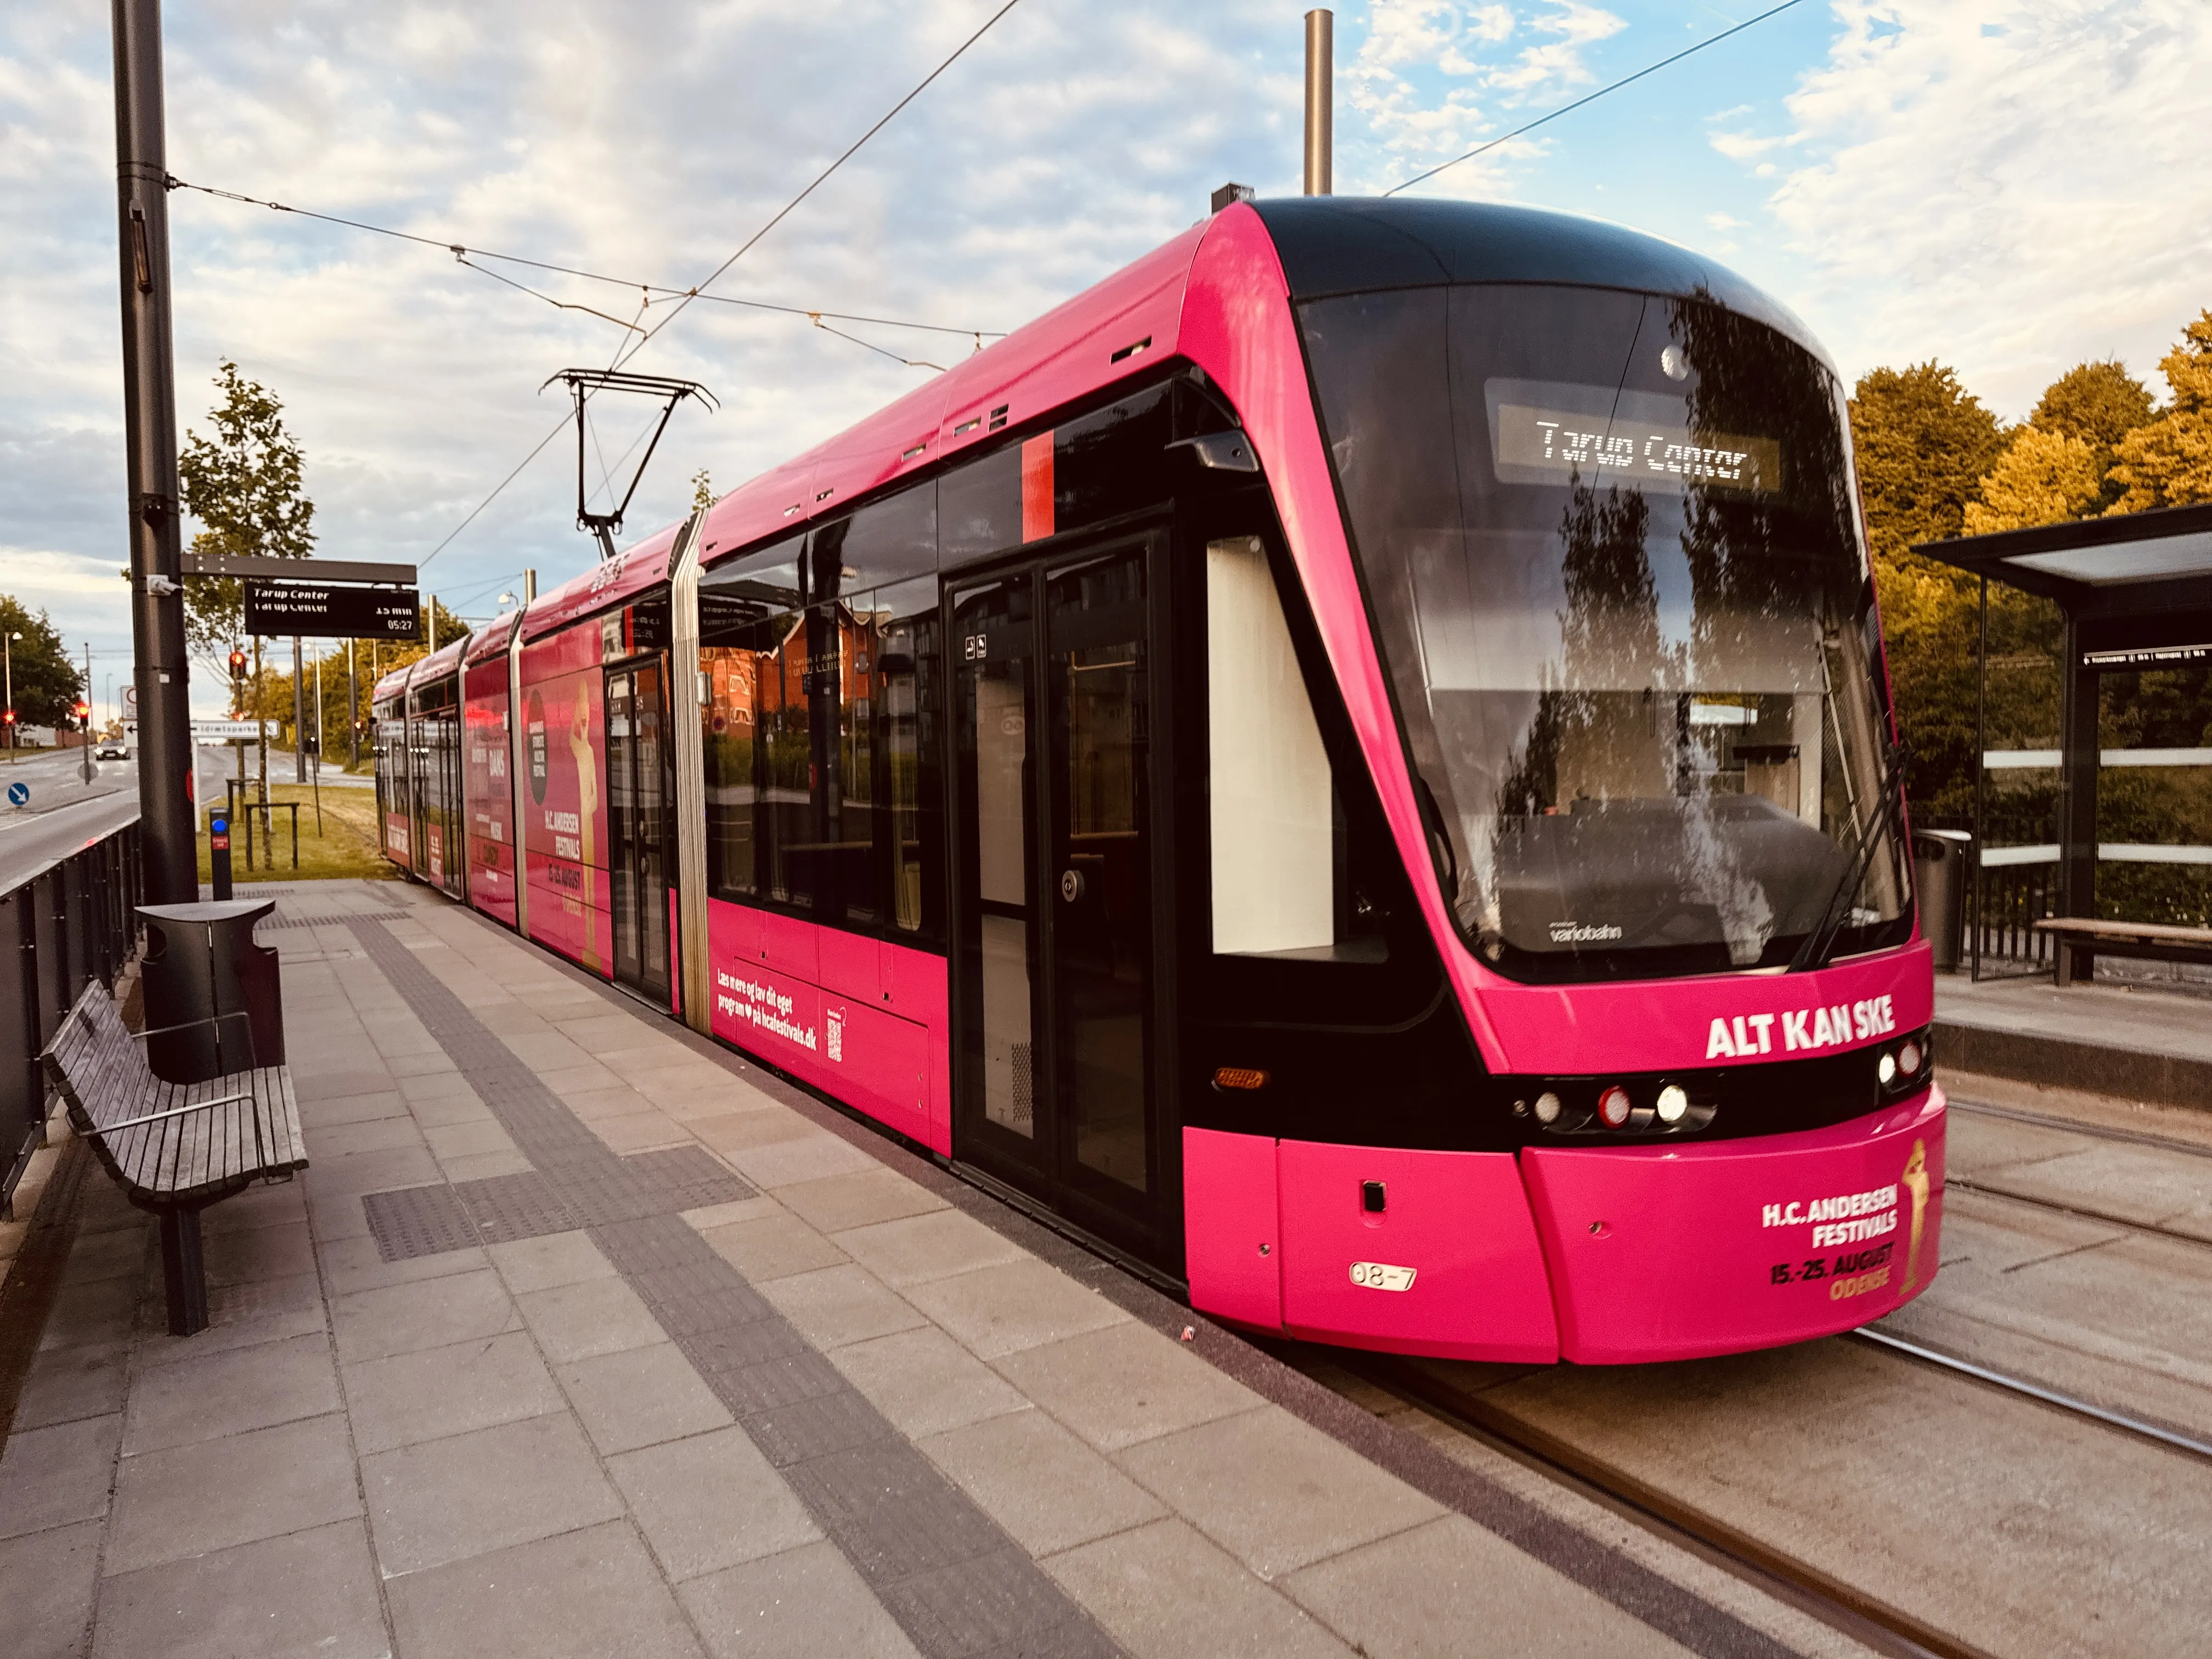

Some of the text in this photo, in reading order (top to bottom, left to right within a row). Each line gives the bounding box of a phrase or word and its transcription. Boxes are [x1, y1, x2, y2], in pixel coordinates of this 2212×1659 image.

[1537, 421, 1633, 467] Tarup
[254, 588, 329, 600] Tarup Center
[387, 620, 412, 630] 05:27
[1549, 924, 1622, 942] variobahn
[718, 968, 793, 1017] Læs mere og lav dit eget
[718, 994, 744, 1017] program
[753, 1004, 761, 1028] på
[761, 1007, 816, 1052] hcafestivals.dk
[1706, 1013, 1775, 1059] ALT
[1812, 1209, 1898, 1249] FESTIVALS
[1350, 1262, 1416, 1290] 08-7
[1770, 1241, 1895, 1285] 15.-25. AUGUST
